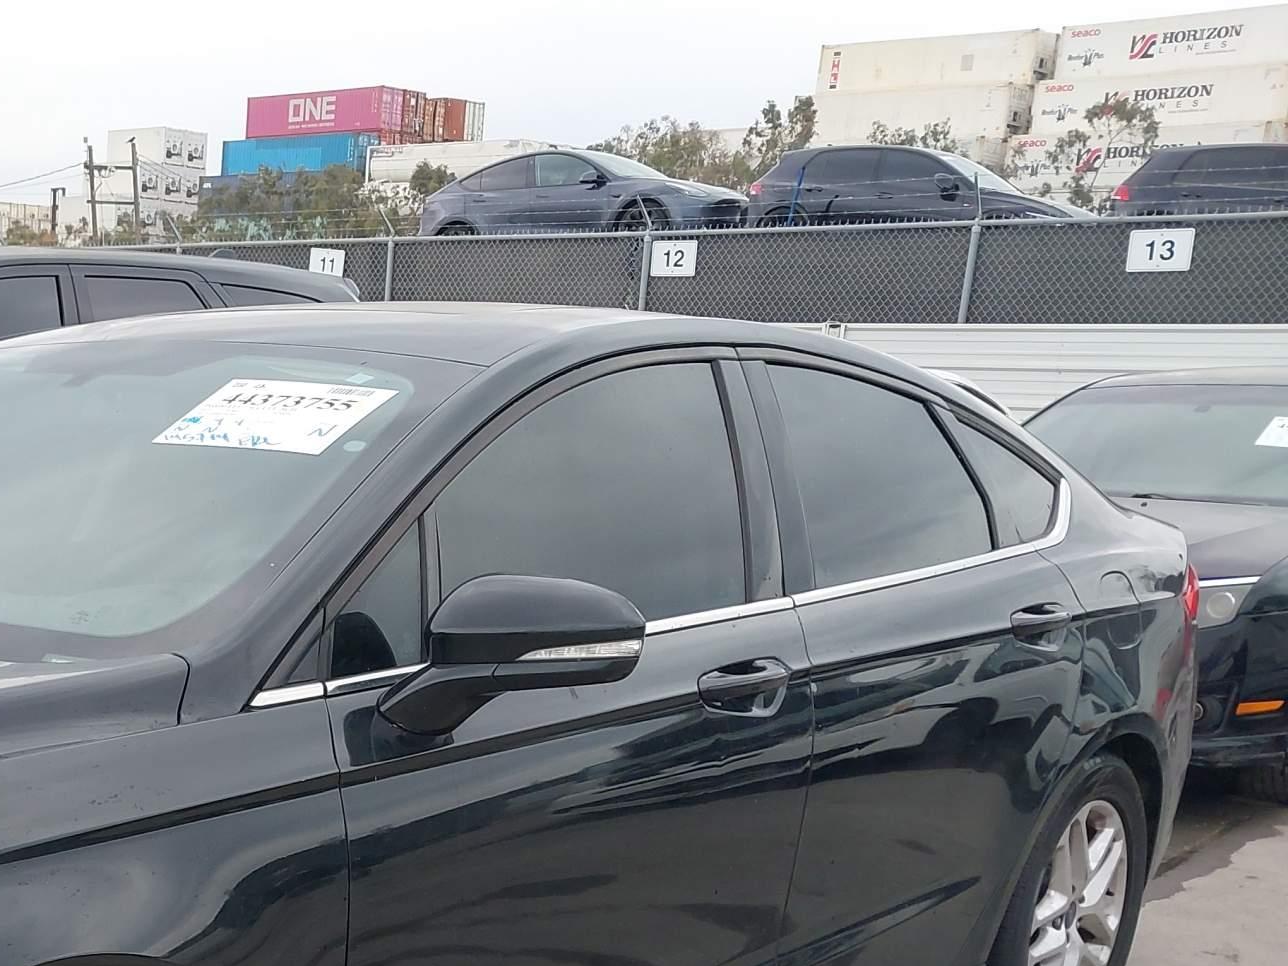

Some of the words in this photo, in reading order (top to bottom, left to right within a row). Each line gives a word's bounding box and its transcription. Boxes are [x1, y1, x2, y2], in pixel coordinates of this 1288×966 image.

[1071, 28, 1102, 38] seaco
[1161, 24, 1244, 45] HORIZON
[1159, 40, 1228, 54] LINES
[1045, 83, 1074, 93] seaco
[1133, 84, 1214, 102] HORIZON
[288, 96, 336, 123] ONE
[1018, 139, 1047, 149] seaco
[663, 249, 685, 268] 12
[1146, 239, 1175, 261] 13
[320, 256, 335, 272] 11
[222, 393, 360, 411] 44373755
